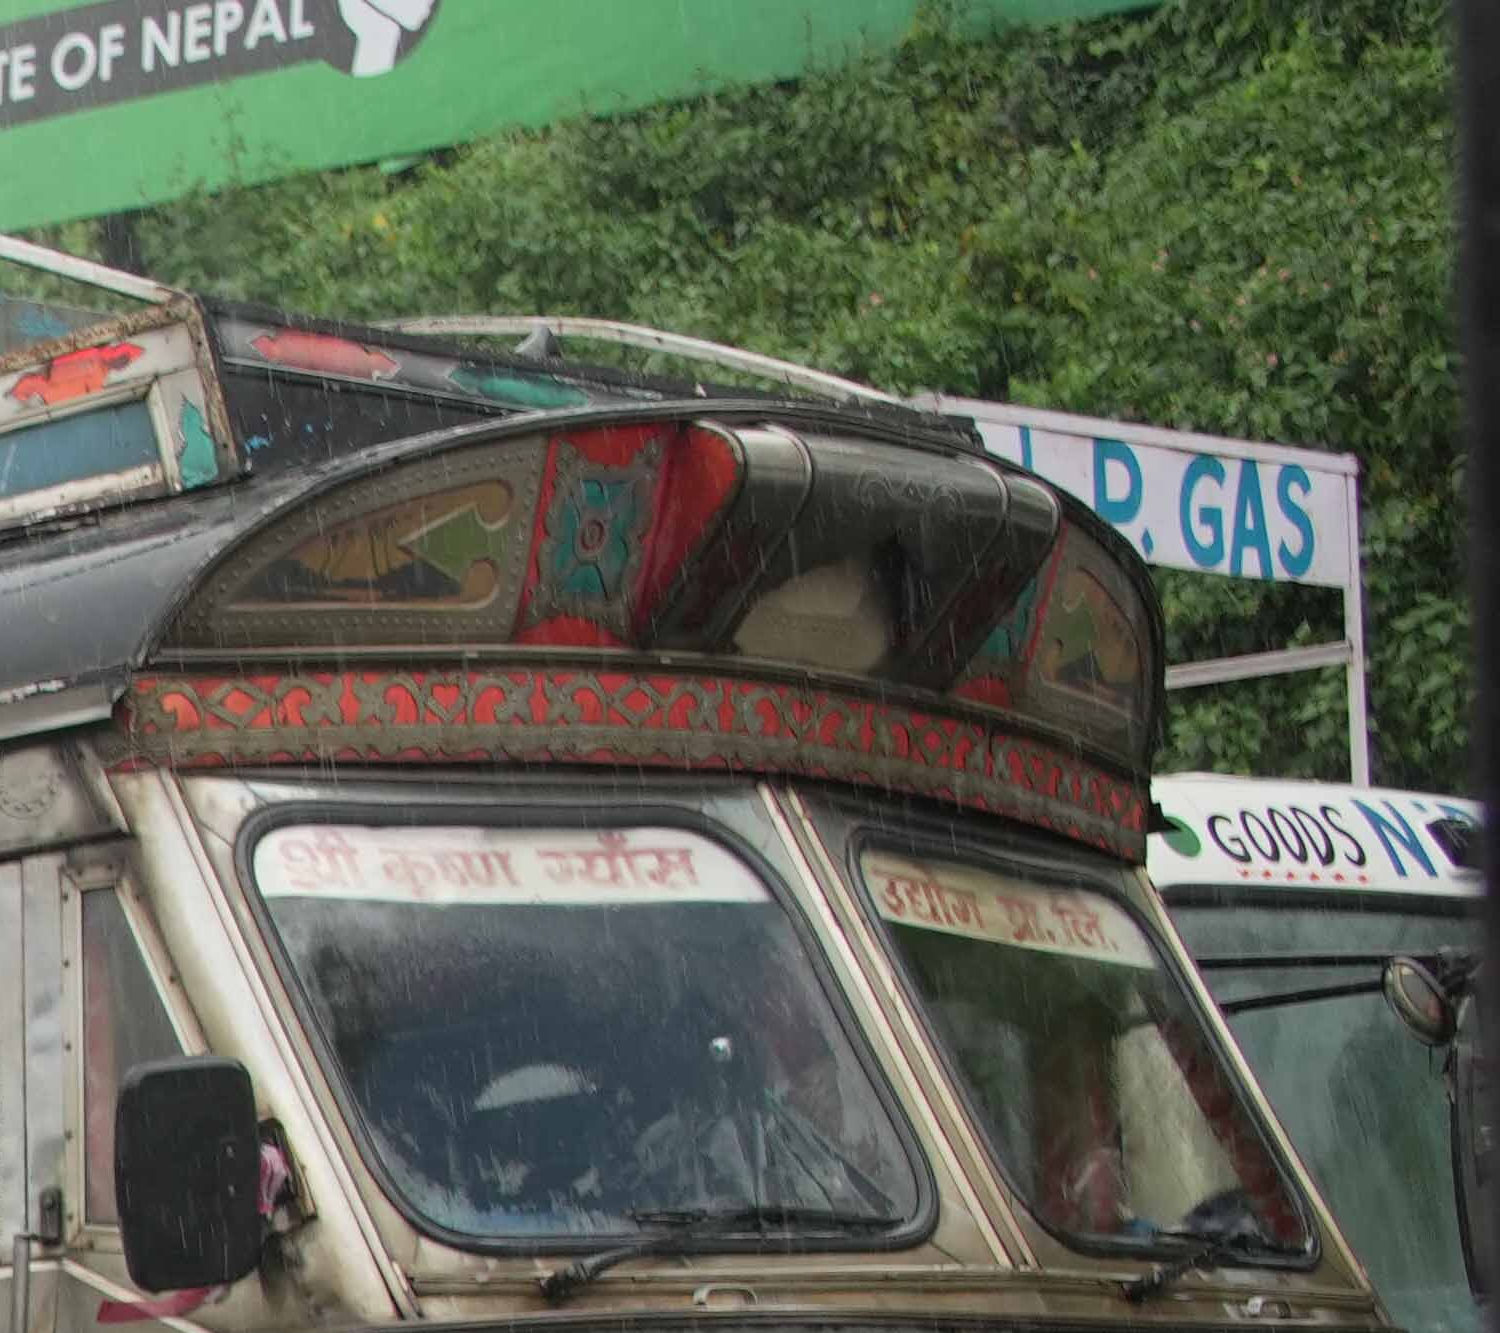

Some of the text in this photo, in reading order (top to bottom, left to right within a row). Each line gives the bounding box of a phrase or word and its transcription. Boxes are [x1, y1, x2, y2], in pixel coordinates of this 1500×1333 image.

[48, 26, 127, 92] OF
[138, 0, 315, 75] NEPAL
[1179, 452, 1316, 583] GAS
[1206, 804, 1367, 868] GOODS
